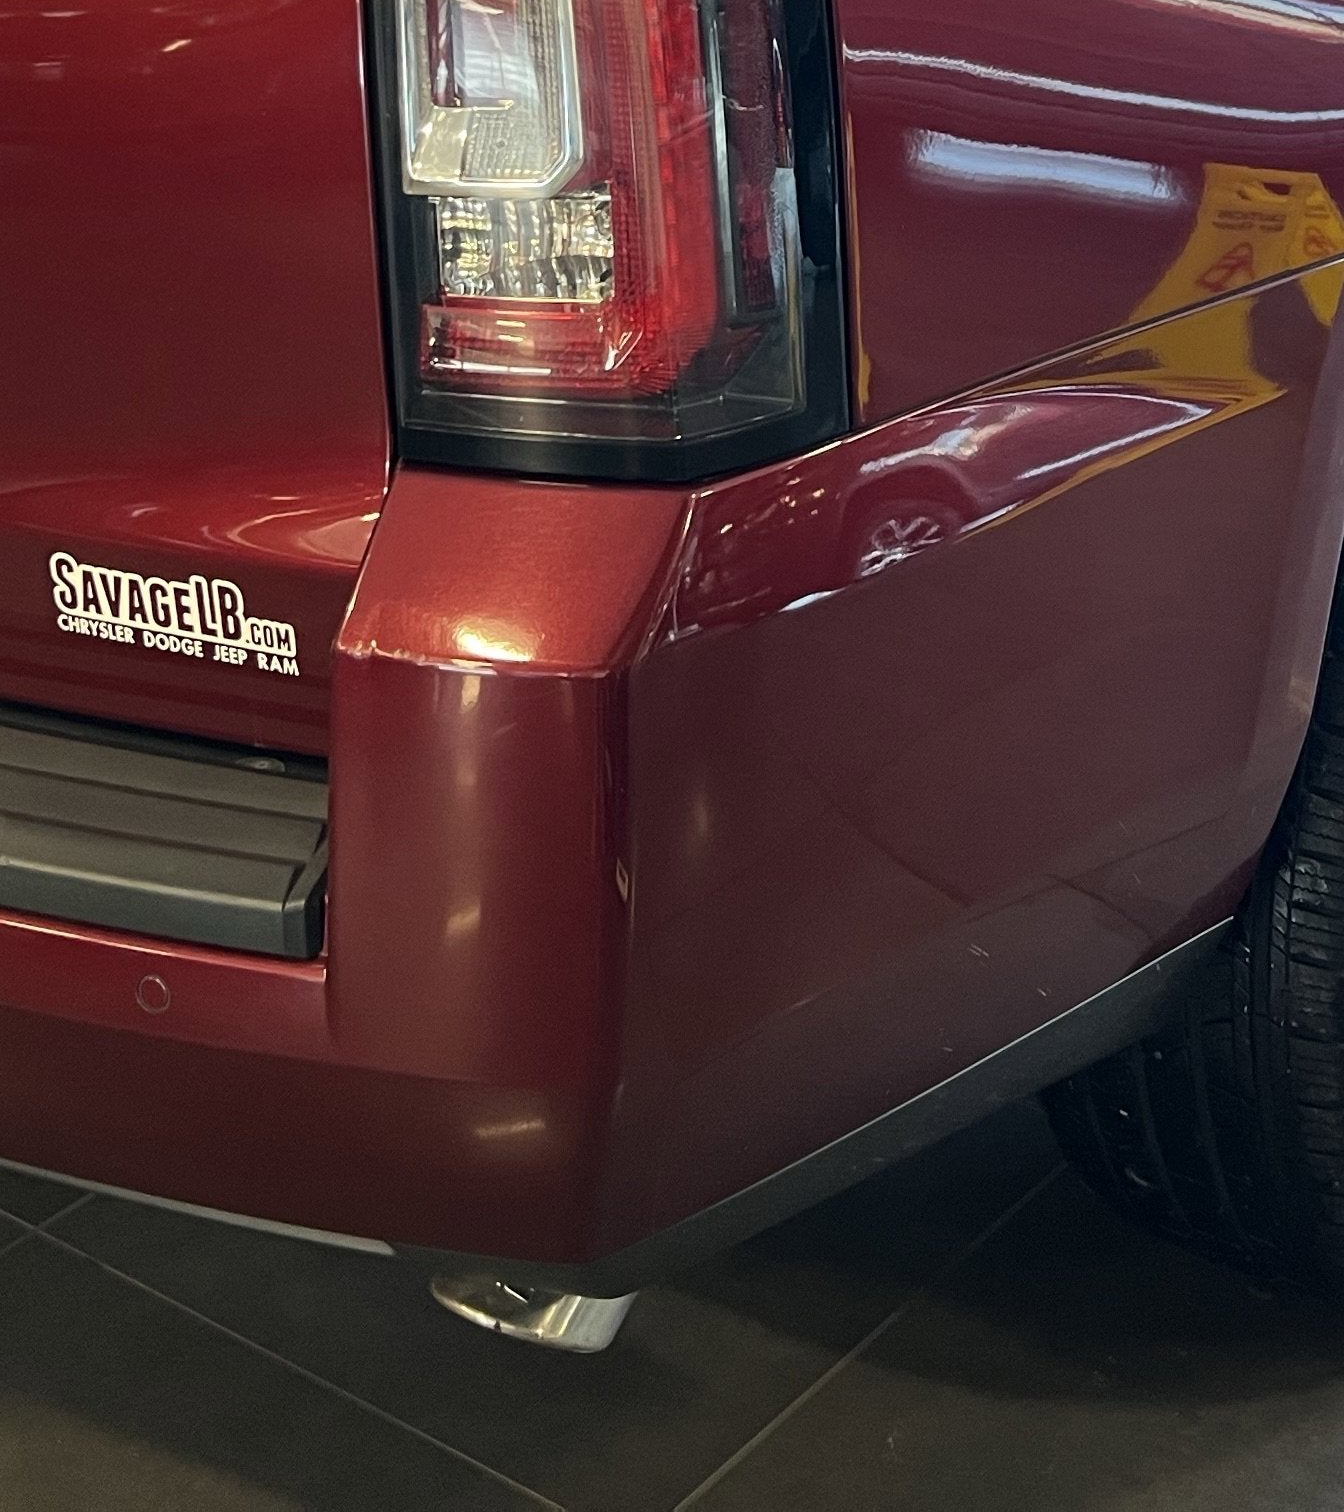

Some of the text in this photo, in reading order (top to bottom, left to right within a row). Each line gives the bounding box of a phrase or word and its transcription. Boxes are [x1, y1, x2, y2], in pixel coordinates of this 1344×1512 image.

[57, 614, 299, 676] CHRYSLER DODGE JEEP RAM
